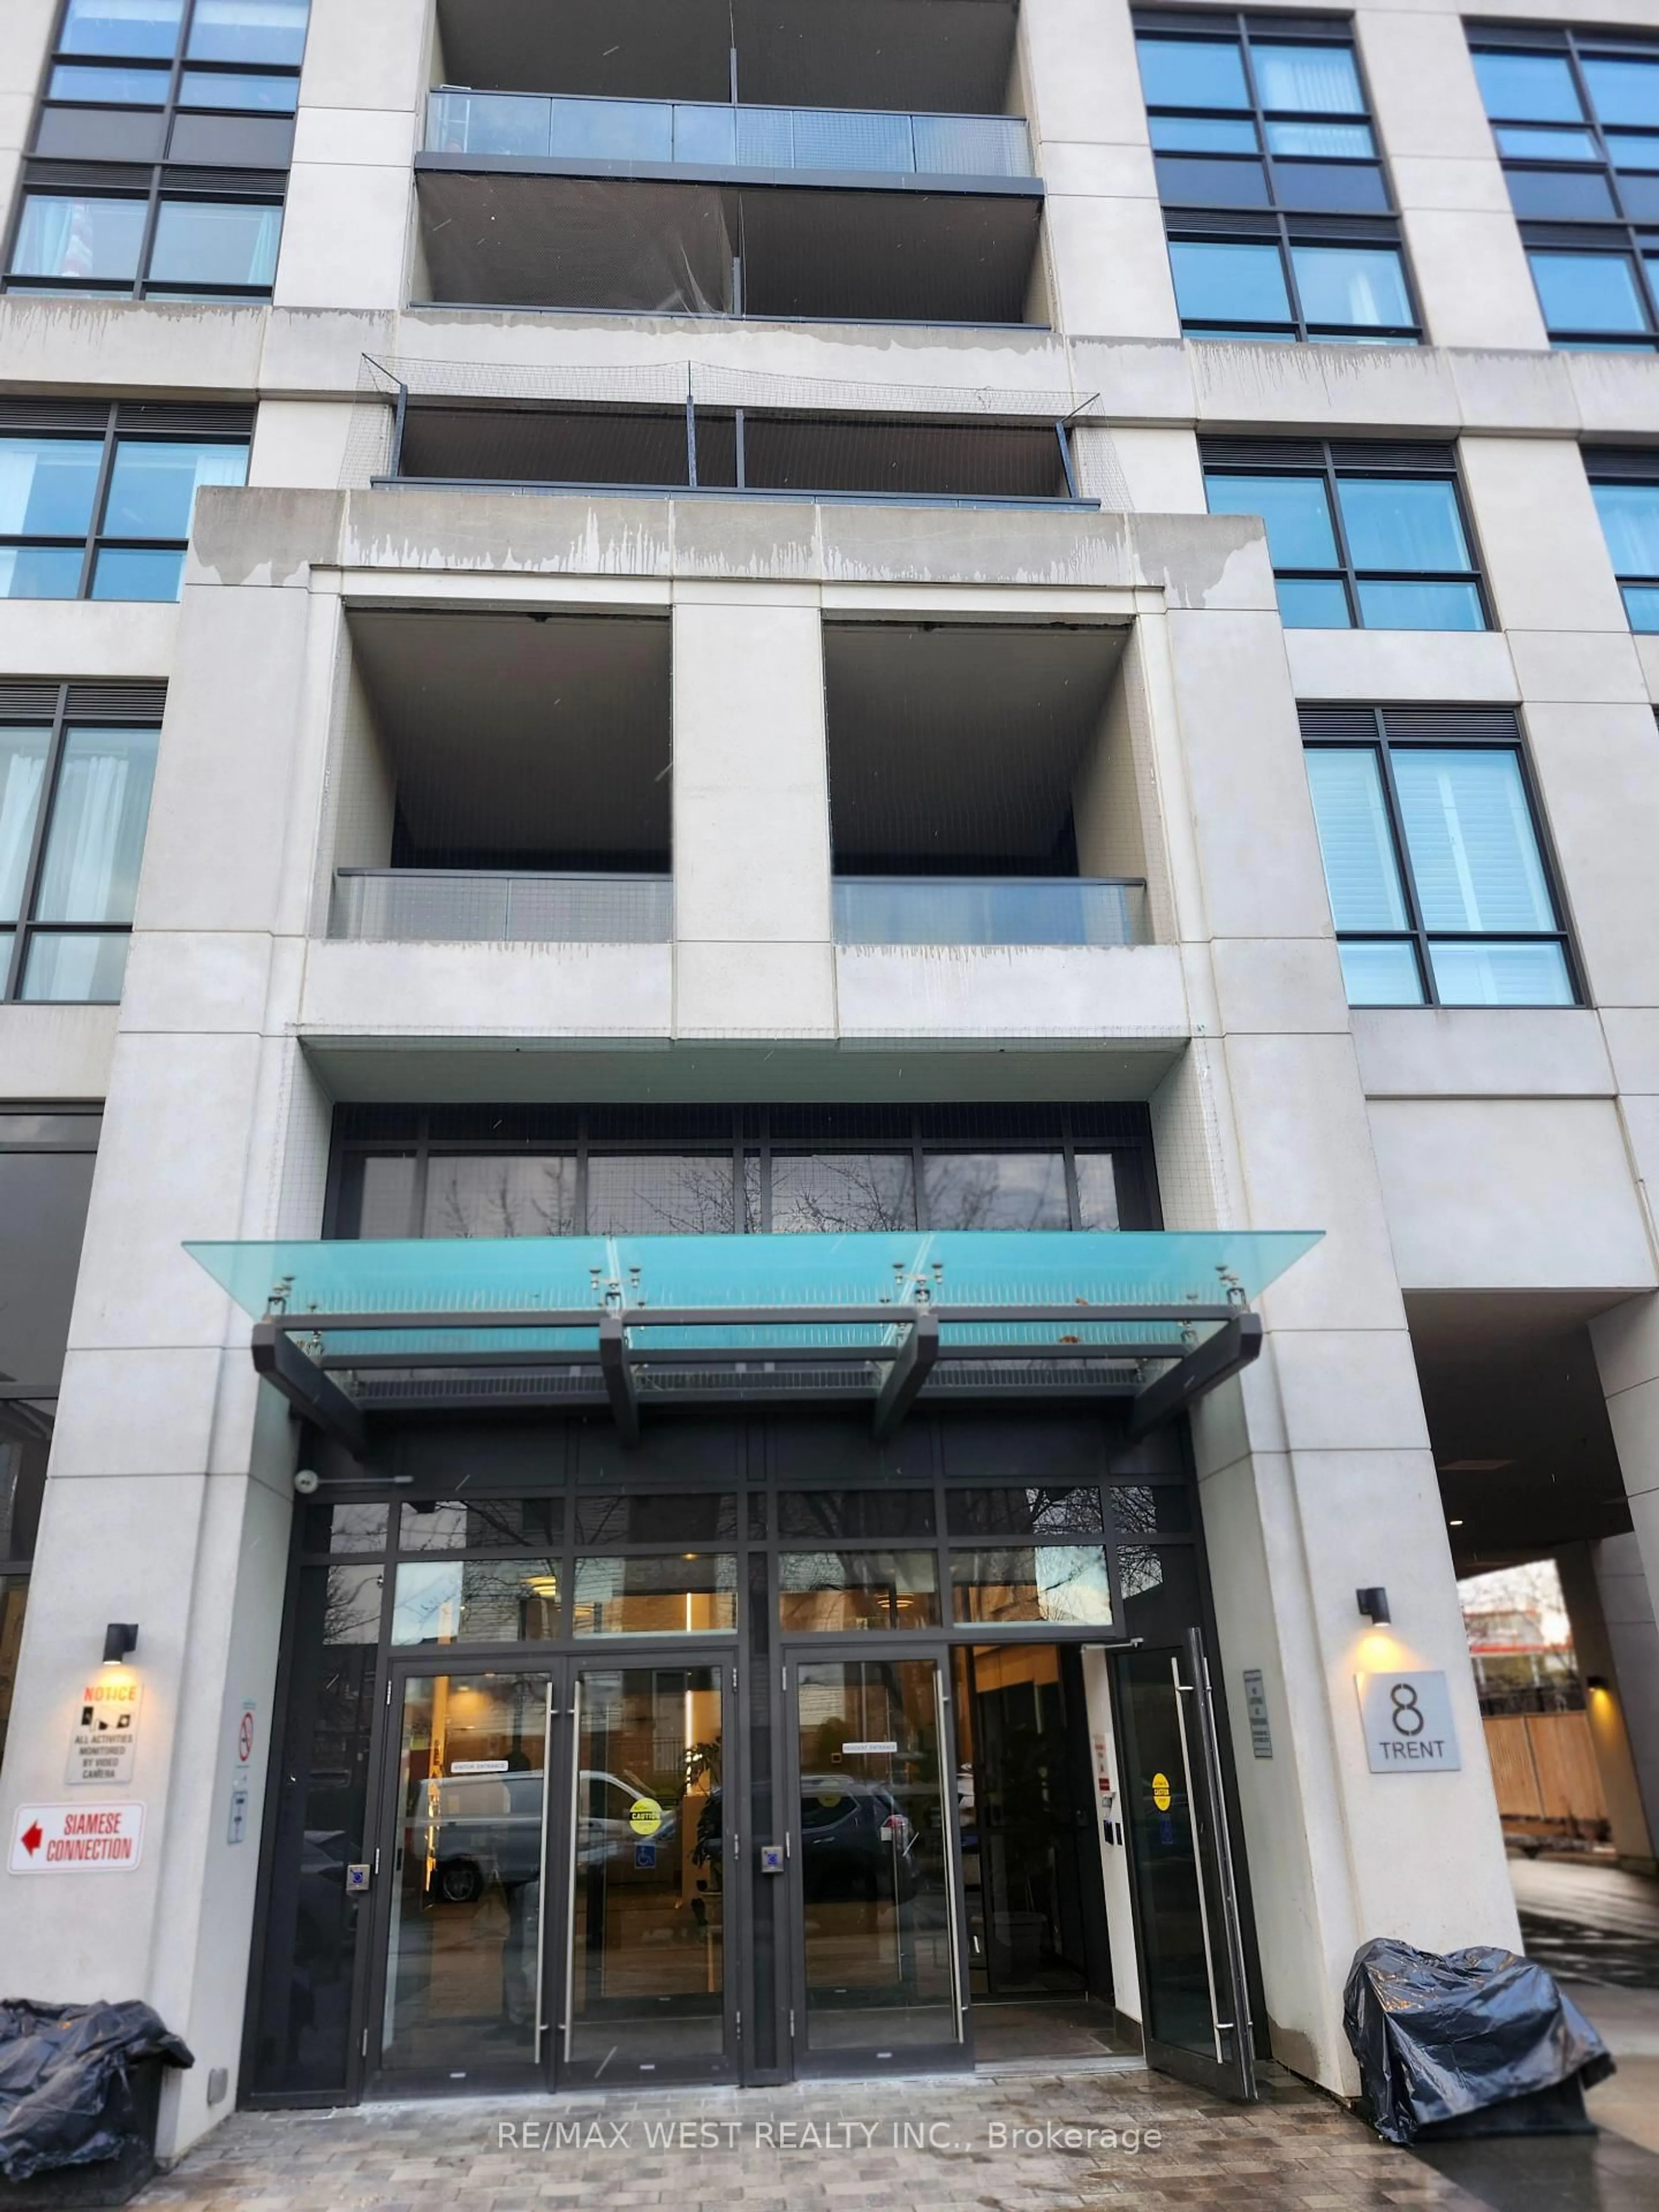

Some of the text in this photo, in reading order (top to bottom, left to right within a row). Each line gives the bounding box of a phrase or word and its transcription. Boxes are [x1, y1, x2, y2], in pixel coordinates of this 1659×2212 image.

[84, 1686, 137, 1701] NOTICE
[1390, 1683, 1424, 1736] 8
[75, 1733, 133, 1744] ALL ACTIVITIES
[79, 1746, 126, 1755] MONITORED
[1379, 1740, 1445, 1760] TRENT
[83, 1758, 119, 1767] BY VIDEO
[83, 1769, 115, 1779] CAMERA
[64, 1812, 122, 1835] SIAMESE
[46, 1837, 132, 1862] CONNECTION
